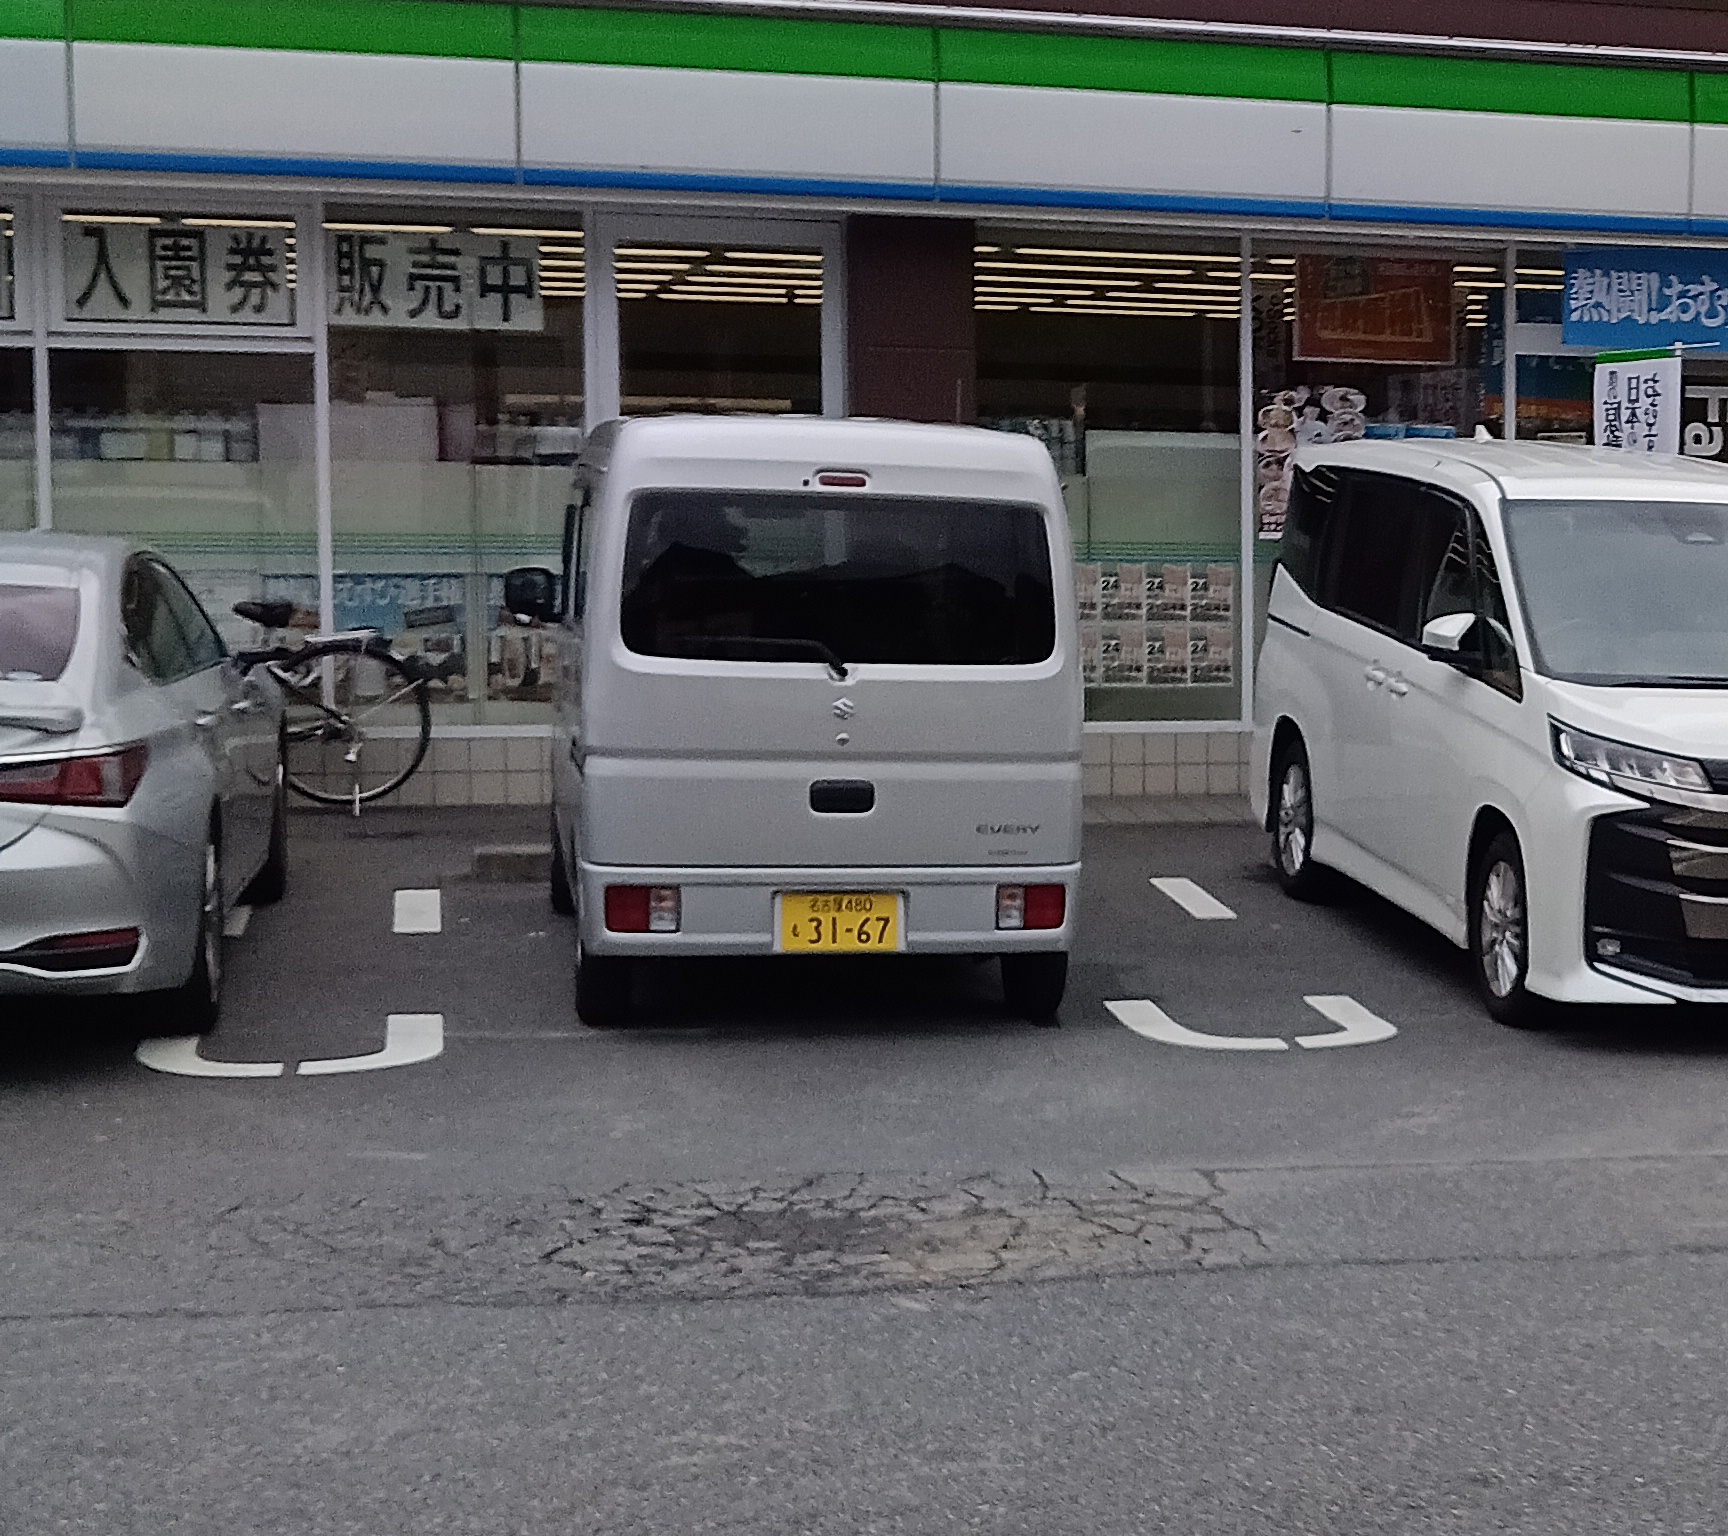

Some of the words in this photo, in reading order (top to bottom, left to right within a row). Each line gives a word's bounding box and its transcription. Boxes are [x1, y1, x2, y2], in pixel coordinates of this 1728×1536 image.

[76, 226, 280, 315] 入園券
[334, 233, 535, 322] 販売中
[1102, 579, 1119, 591] 24
[1147, 580, 1164, 592] 24
[1191, 581, 1208, 593] 24
[1102, 642, 1120, 654] 24
[1147, 643, 1164, 655] 24
[1190, 642, 1207, 654] 24
[807, 916, 890, 944] 31-67
